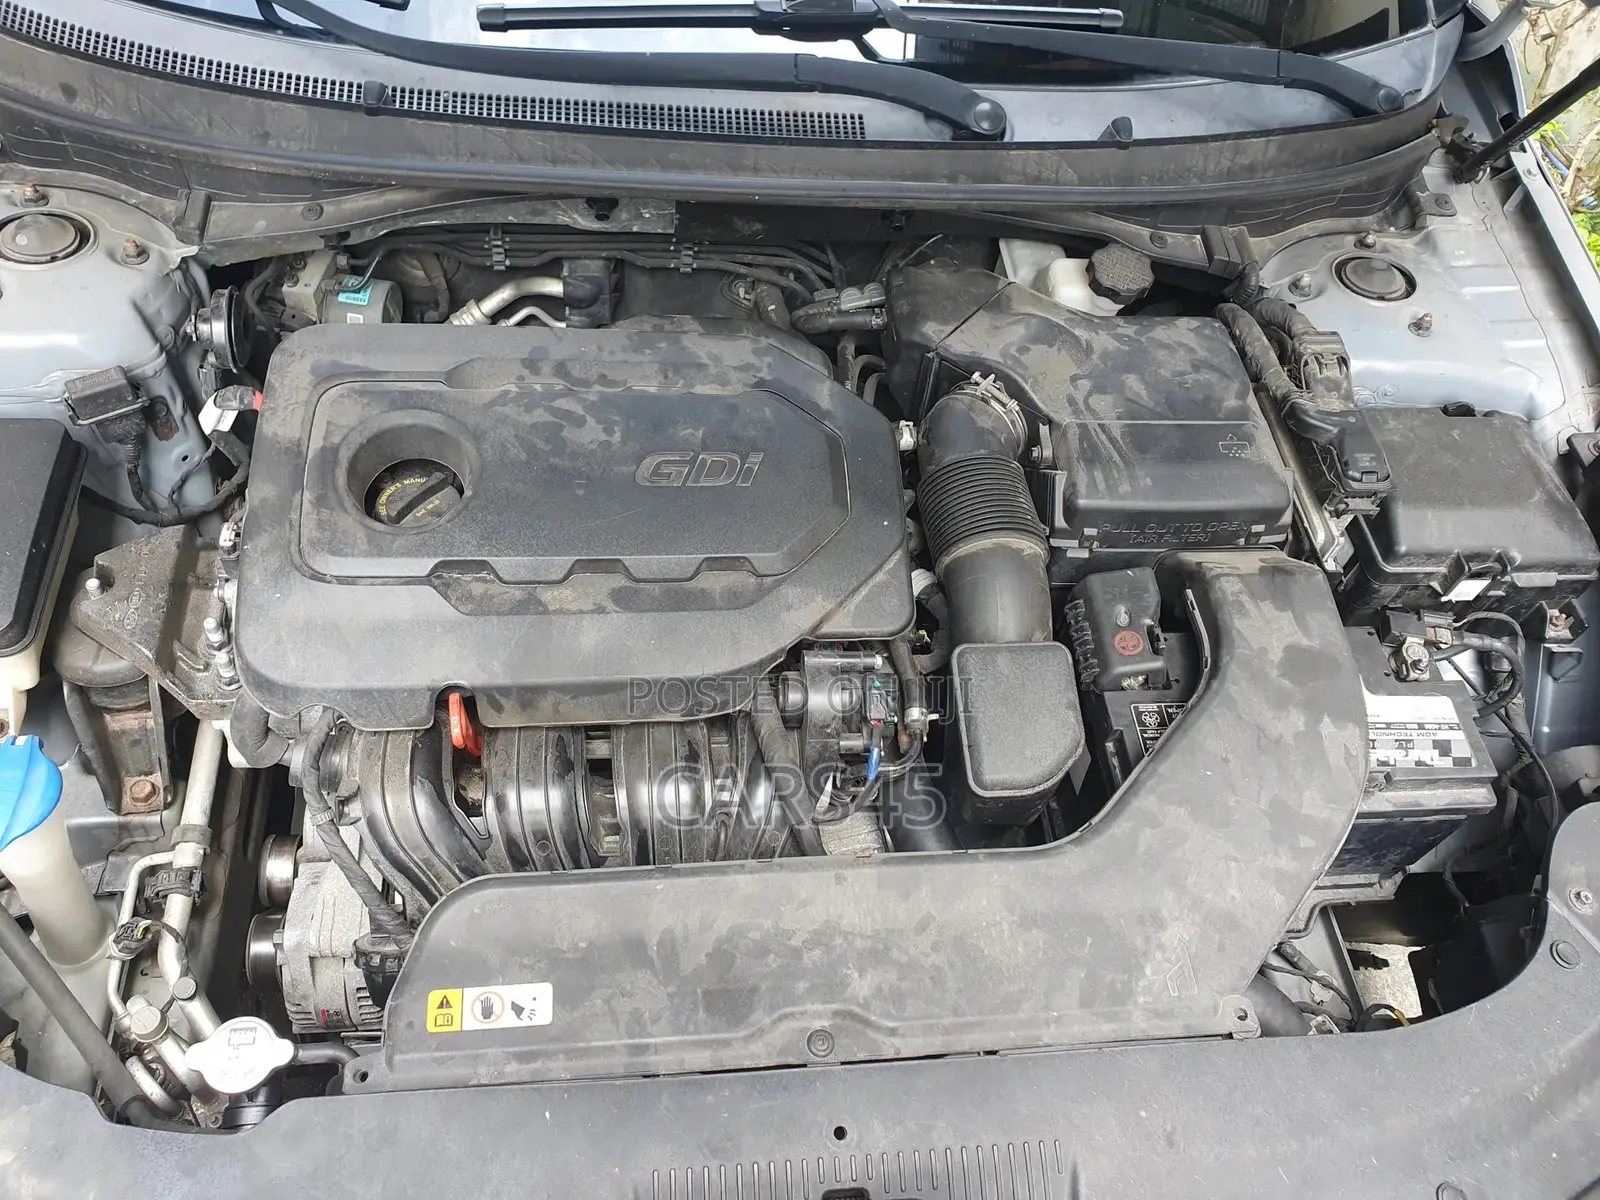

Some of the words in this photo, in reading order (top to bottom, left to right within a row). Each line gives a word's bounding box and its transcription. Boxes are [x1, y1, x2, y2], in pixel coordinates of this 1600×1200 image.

[634, 451, 764, 487] GDi
[403, 476, 429, 485] MANU
[1099, 523, 1141, 533] PULL
[1144, 523, 1179, 533] OUT
[1184, 522, 1202, 533] TO
[1206, 521, 1250, 532] OPEN
